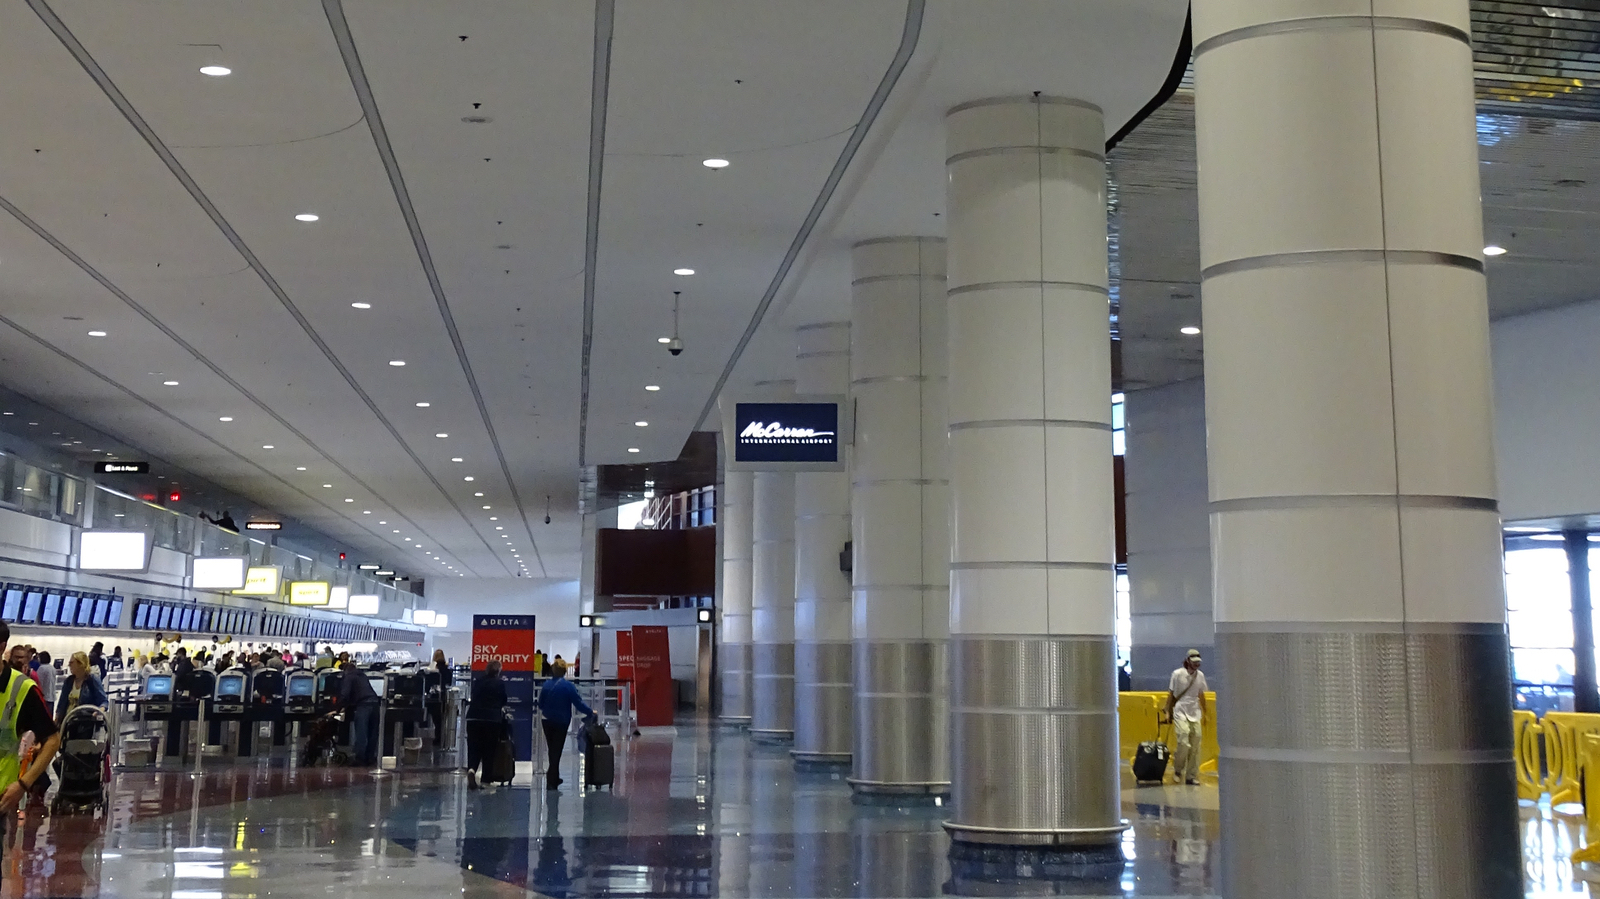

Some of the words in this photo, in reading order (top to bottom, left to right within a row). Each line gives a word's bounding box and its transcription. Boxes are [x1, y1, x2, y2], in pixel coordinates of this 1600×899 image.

[740, 421, 834, 438] McCarran
[474, 645, 498, 654] SKY
[473, 654, 529, 663] PRIORITY
